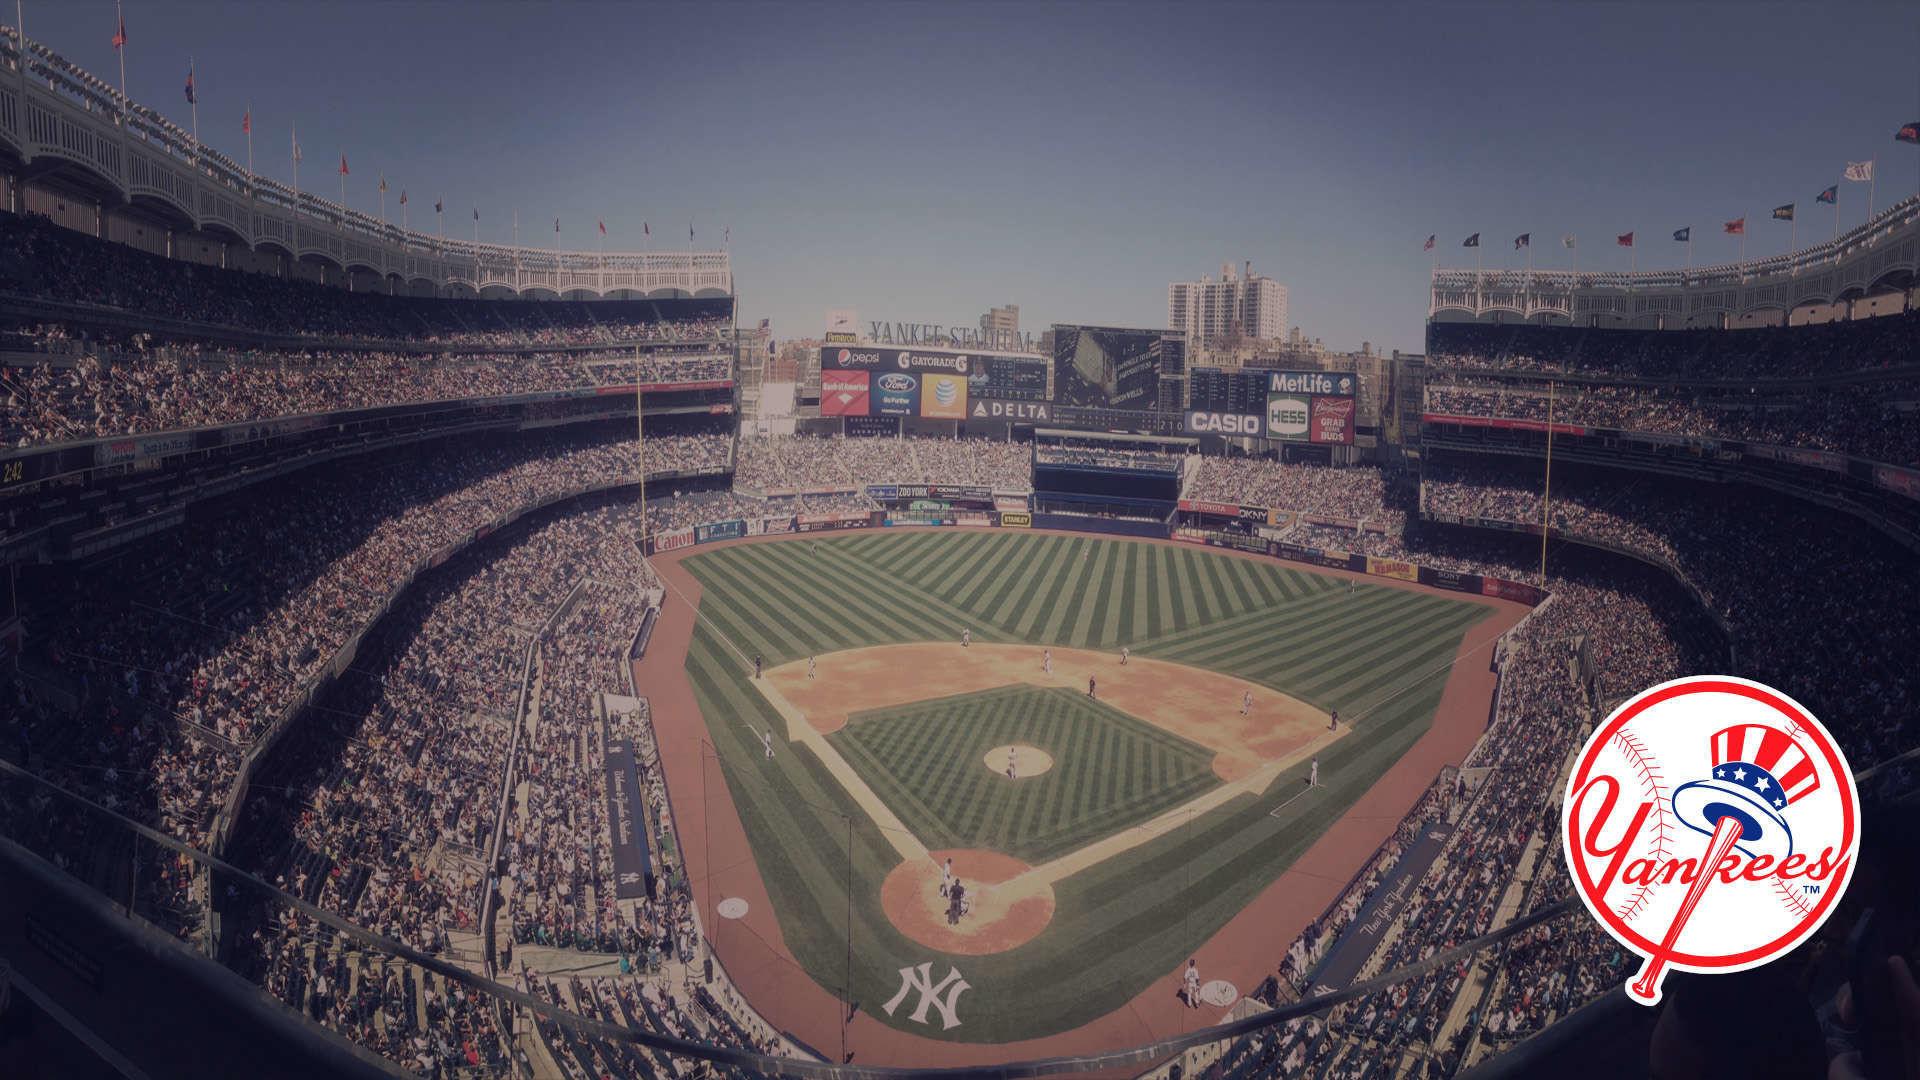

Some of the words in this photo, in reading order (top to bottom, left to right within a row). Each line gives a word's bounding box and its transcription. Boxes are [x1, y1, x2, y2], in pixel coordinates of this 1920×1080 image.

[871, 321, 943, 347] YANKEE
[950, 327, 1032, 353] STADIUM
[852, 352, 880, 367] pepsi
[1271, 373, 1333, 394] MetLife
[992, 402, 1047, 419] DELTA
[1271, 409, 1306, 424] HESS
[1191, 412, 1260, 434] CASIO
[4, 460, 23, 481] 2:42
[899, 487, 911, 497] ZOO
[911, 487, 928, 497] YORK
[1200, 503, 1226, 513] TOYOTA
[655, 530, 694, 551] Canon
